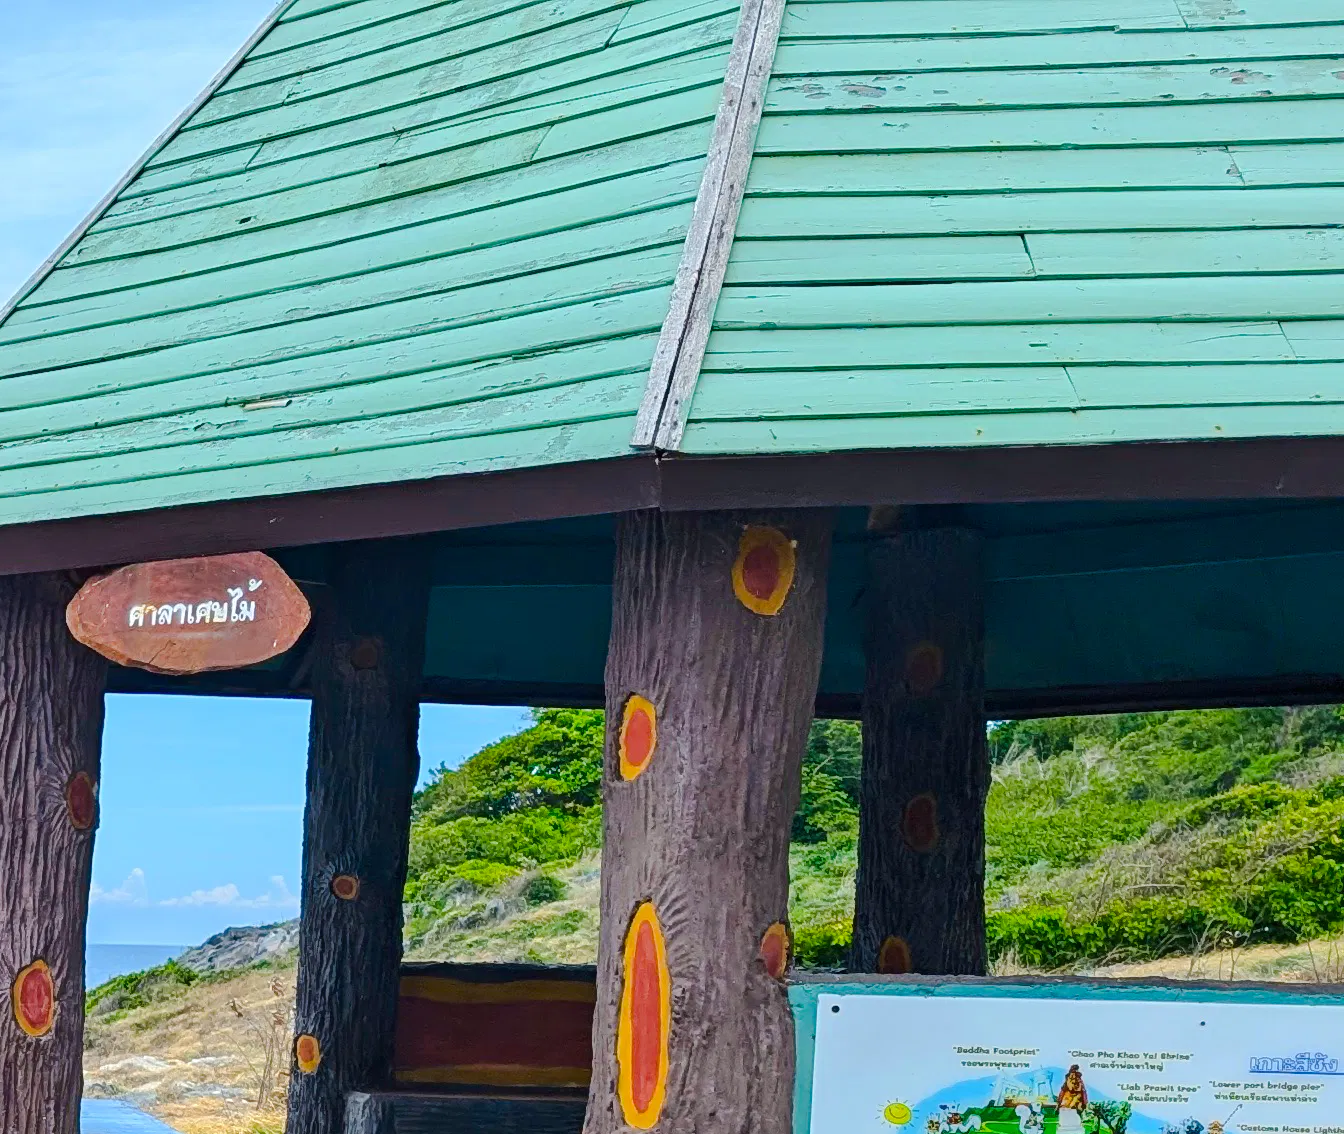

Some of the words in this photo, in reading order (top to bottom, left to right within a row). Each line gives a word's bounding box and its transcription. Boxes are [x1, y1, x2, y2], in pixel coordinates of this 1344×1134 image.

[128, 578, 262, 628] ศาลาเศษไม้
[1098, 1051, 1115, 1059] Pho
[1243, 1081, 1264, 1090] port
[1267, 1081, 1298, 1091] bridge
